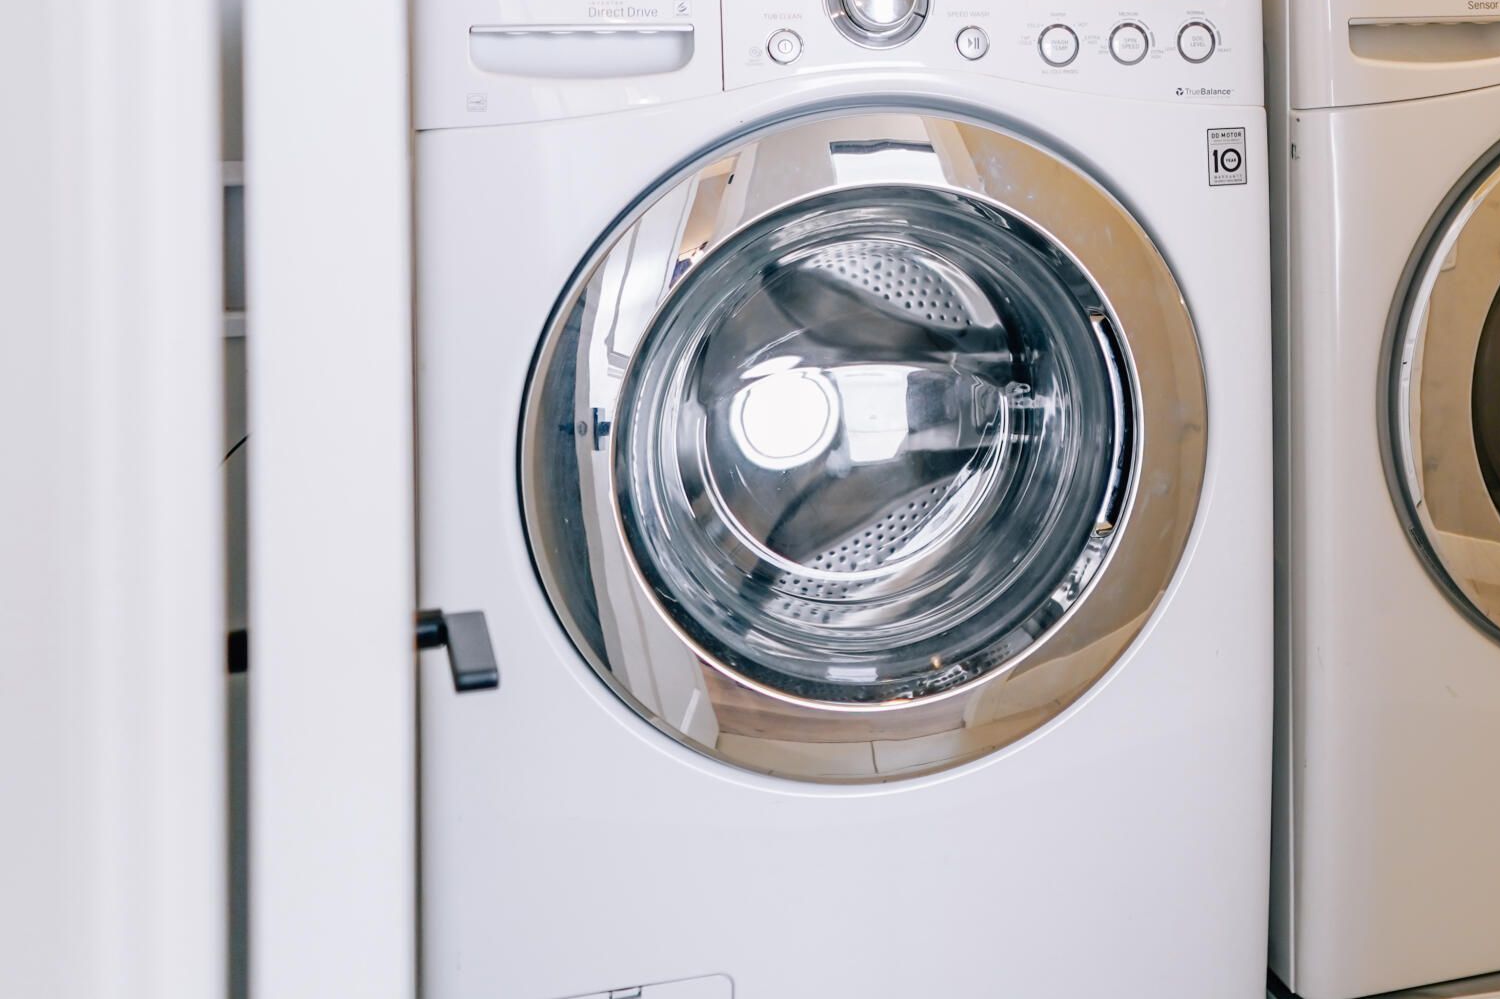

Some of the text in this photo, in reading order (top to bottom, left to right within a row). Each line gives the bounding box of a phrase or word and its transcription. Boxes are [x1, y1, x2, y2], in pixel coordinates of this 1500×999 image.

[1467, 0, 1499, 10] Sensor
[588, 6, 659, 18] Direct Drive
[1185, 87, 1232, 97] TrueBalance
[1211, 131, 1242, 140] DD MOTOR
[1212, 147, 1242, 174] 10
